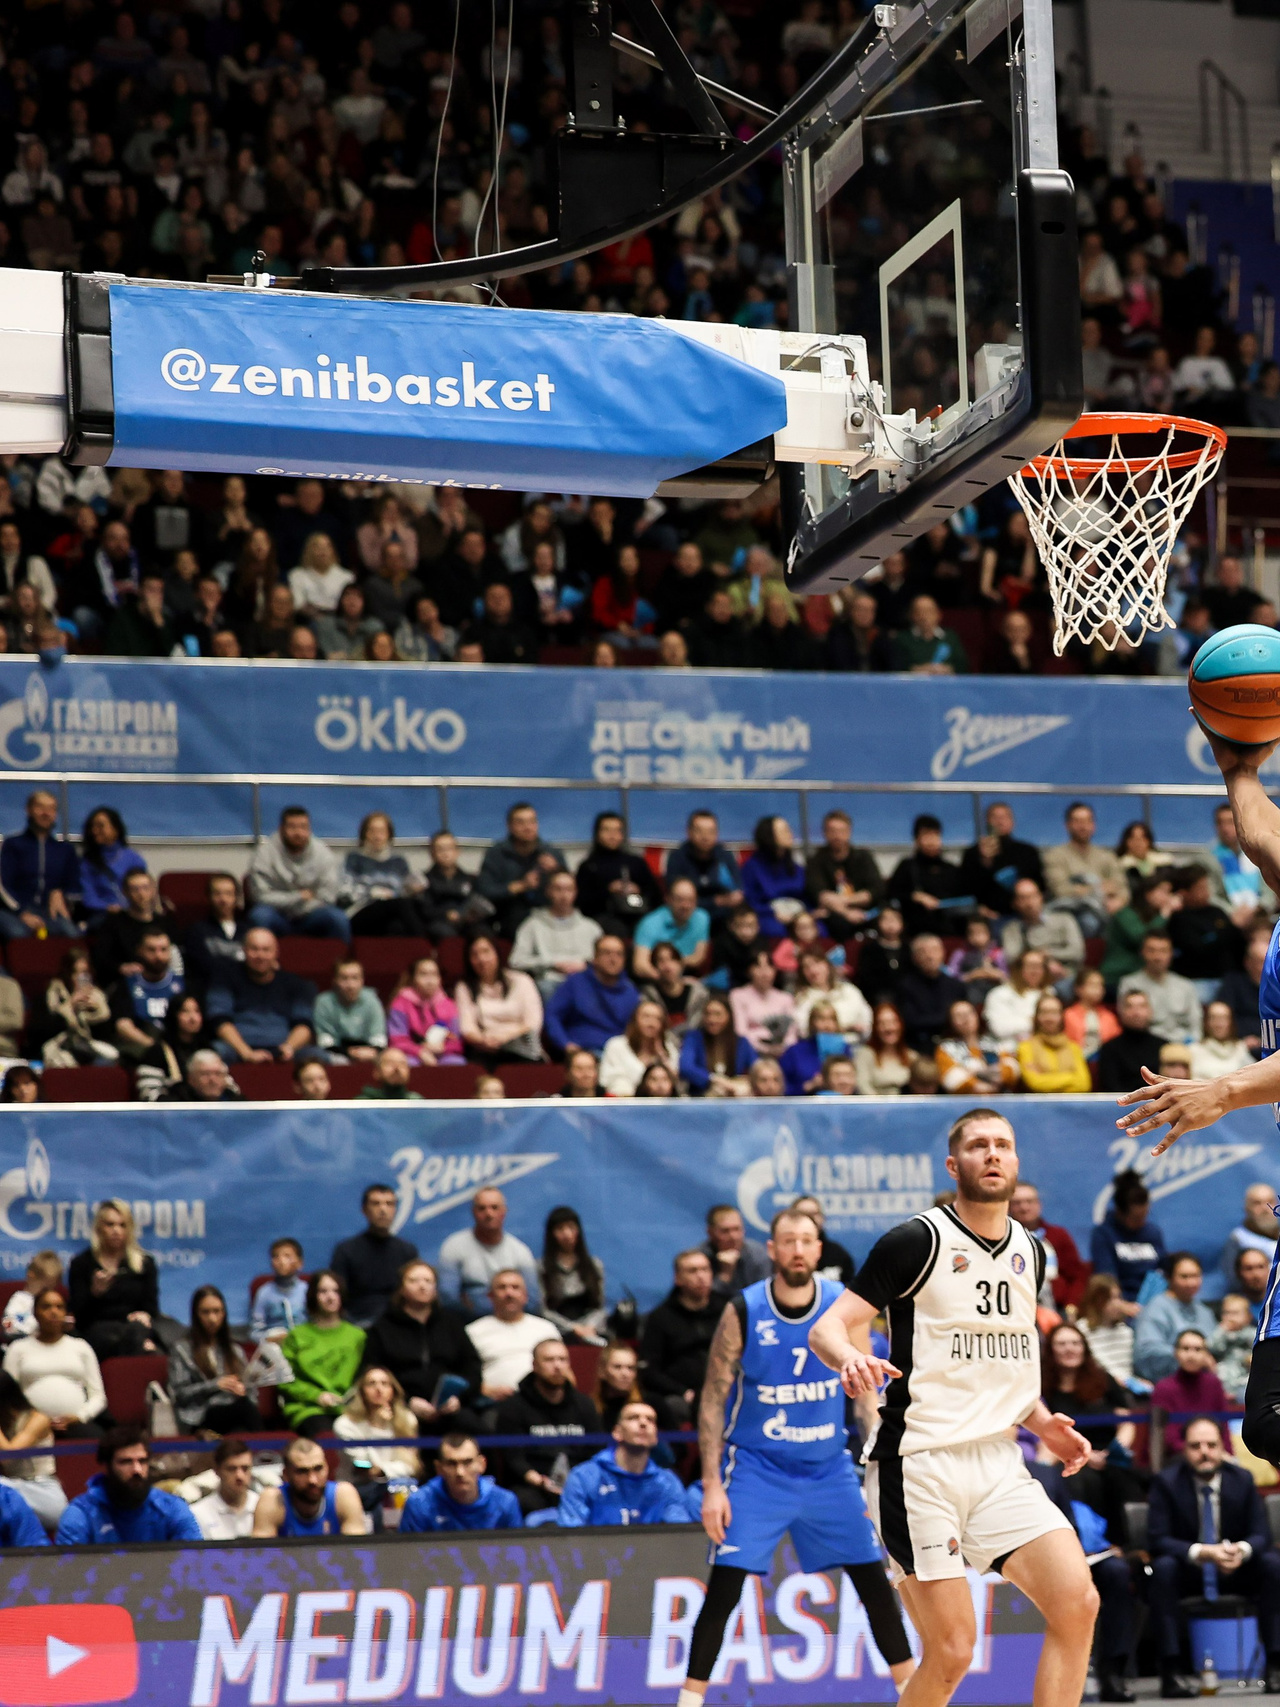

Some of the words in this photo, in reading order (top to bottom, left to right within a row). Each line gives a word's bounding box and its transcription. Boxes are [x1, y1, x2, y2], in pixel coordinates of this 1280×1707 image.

[160, 347, 556, 412] @zenitbasket
[53, 699, 178, 733] ГАЗПРОМ
[590, 716, 811, 752] ДЕСЯТЫЙ
[592, 753, 745, 785] СЕЗОН
[802, 1153, 933, 1190] ГАЗПРОМ
[56, 1200, 206, 1240] ГАРОМ
[976, 1280, 1010, 1316] 30
[791, 1347, 808, 1377] 7
[951, 1333, 1031, 1360] AVTODOR
[757, 1377, 841, 1405] ZENIT
[190, 1579, 610, 1707] MEDIUM
[646, 1574, 998, 1688] BASKT
